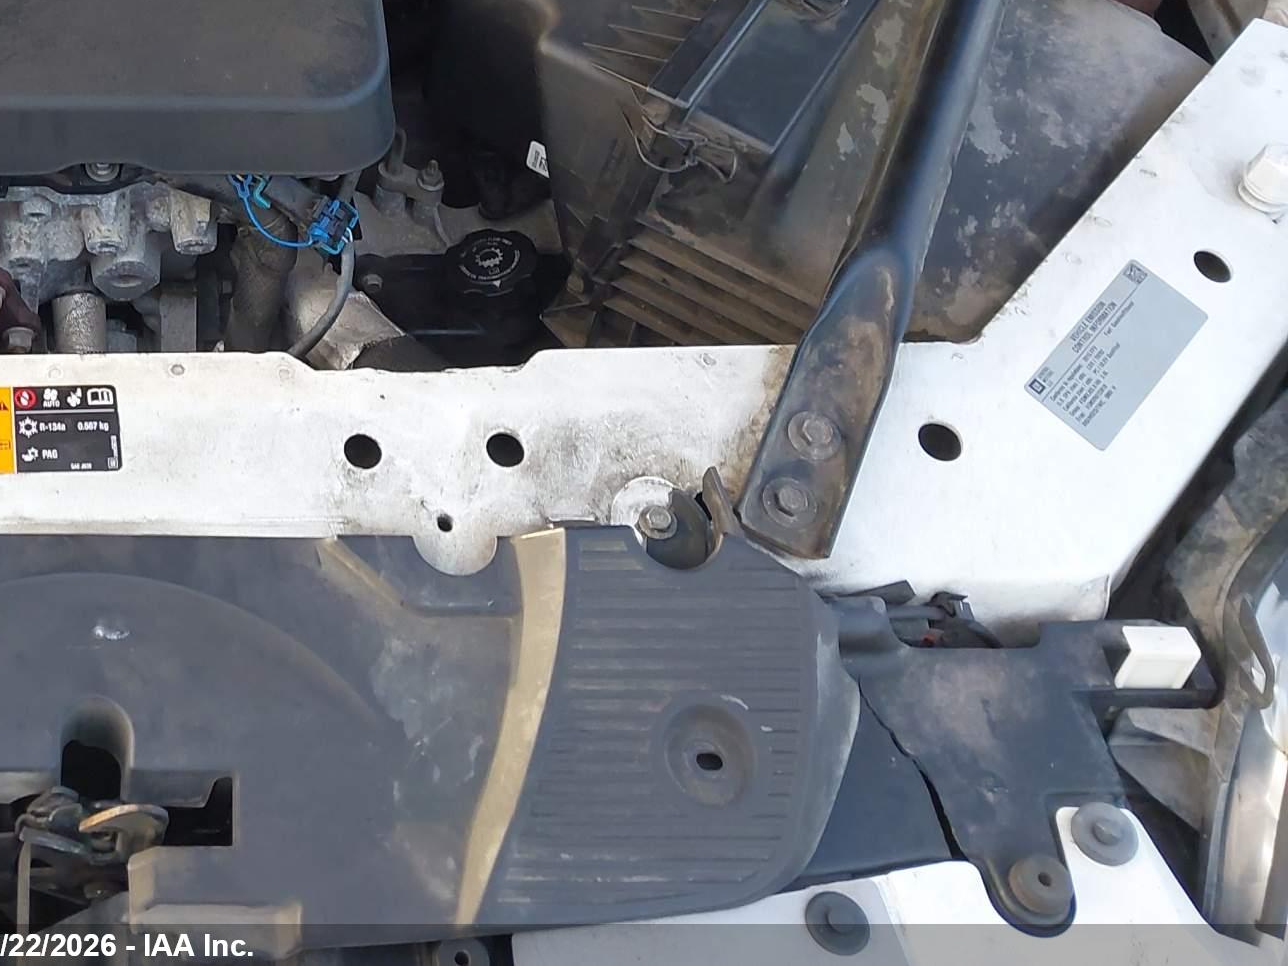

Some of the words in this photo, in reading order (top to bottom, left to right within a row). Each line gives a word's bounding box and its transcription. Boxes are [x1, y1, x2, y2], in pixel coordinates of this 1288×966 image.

[1069, 321, 1088, 342] VEHICLE
[1070, 329, 1093, 353] CONTROL
[1088, 300, 1117, 333] INFORMATION
[99, 420, 109, 431] kg
